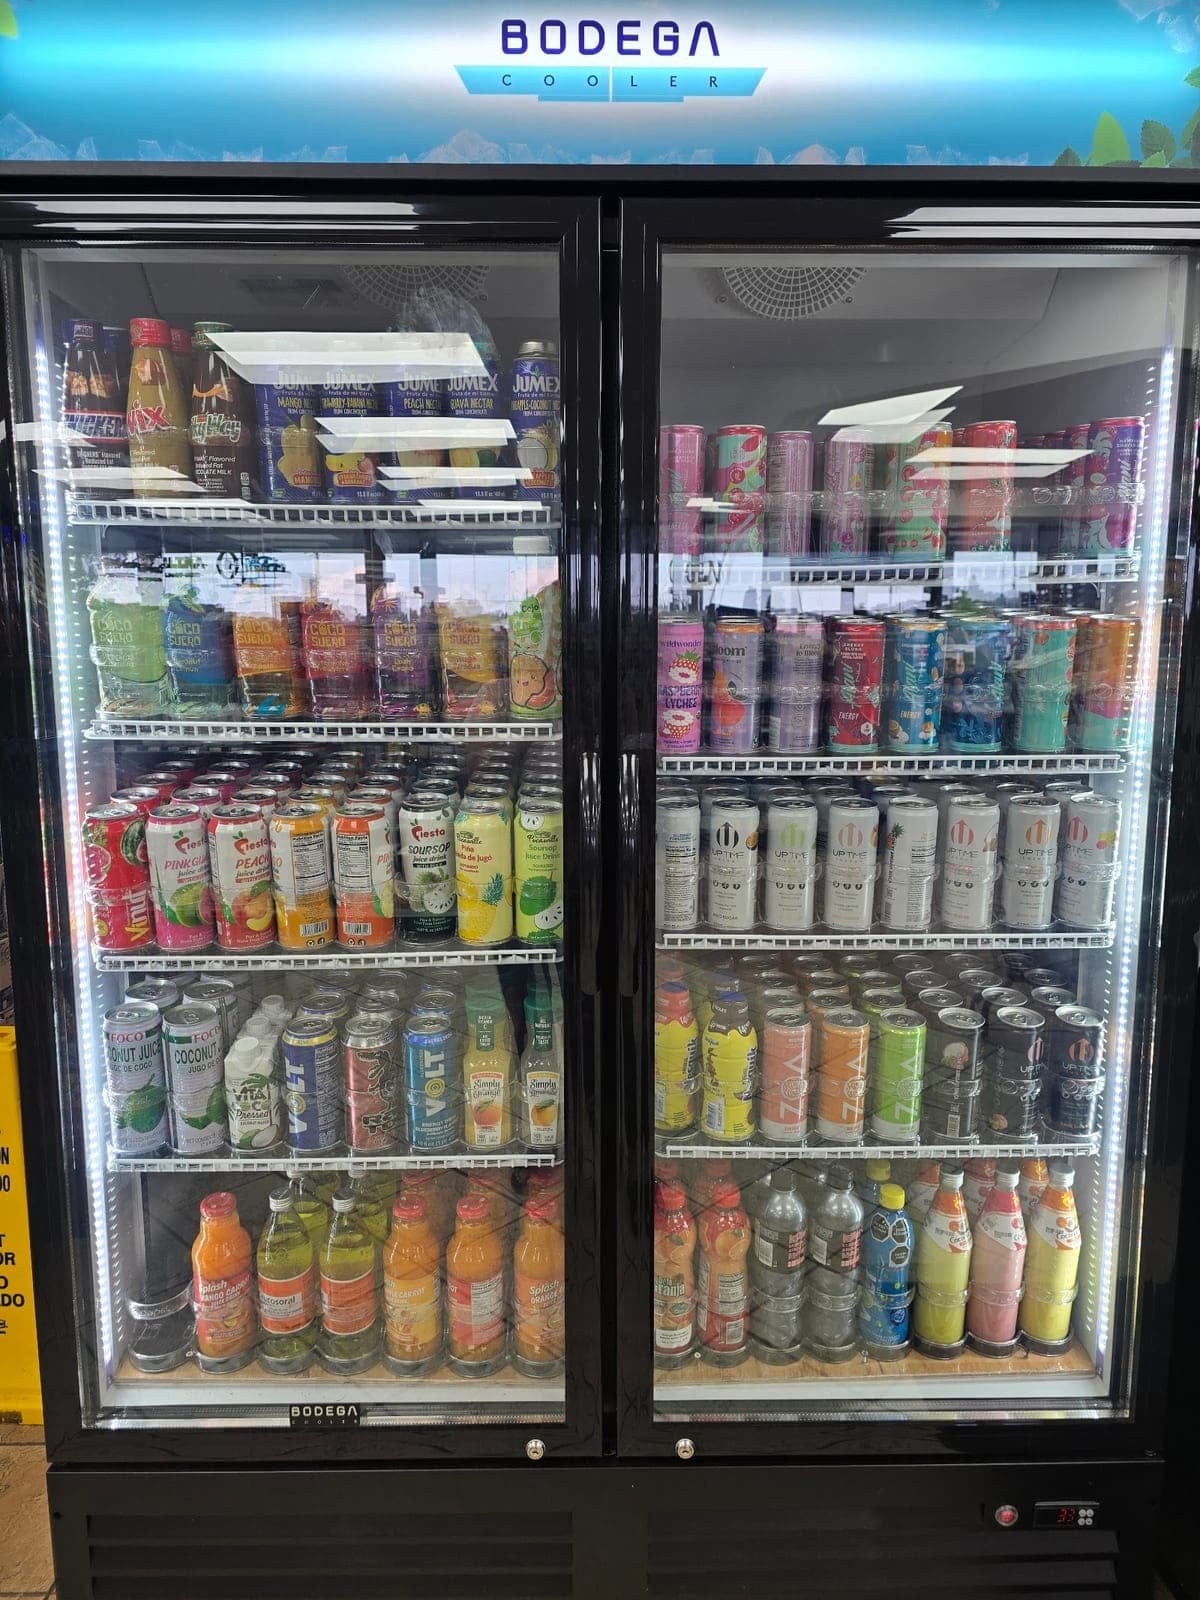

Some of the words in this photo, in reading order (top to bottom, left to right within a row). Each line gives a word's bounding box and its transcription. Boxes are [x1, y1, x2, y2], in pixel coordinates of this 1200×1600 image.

[501, 19, 720, 56] BODEGA
[502, 74, 719, 88] COOLER
[448, 373, 498, 392] JUMEX
[513, 374, 560, 392] JUMEX
[168, 620, 200, 634] COCO
[310, 622, 346, 636] COCO
[384, 622, 416, 635] COCO
[169, 635, 200, 646] SUERO
[312, 636, 346, 647] SUERO
[385, 635, 417, 647] SUERO
[665, 698, 697, 709] LYCHEE
[838, 711, 859, 720] ENERGY
[900, 711, 921, 719] ENERGY
[408, 842, 451, 855] SOURSOP
[529, 844, 558, 853] Soursop
[164, 858, 191, 870] PINK
[235, 854, 270, 869] PEACH
[429, 853, 447, 862] drink
[111, 1031, 144, 1044] FOCO
[193, 1026, 222, 1044] FOCO
[174, 1042, 218, 1065] COCONUT
[424, 1050, 446, 1118] VOLT
[473, 1079, 500, 1090] Simply
[530, 1078, 557, 1090] Simply
[529, 1279, 560, 1296] Splash
[291, 1405, 358, 1417] BODEGA
